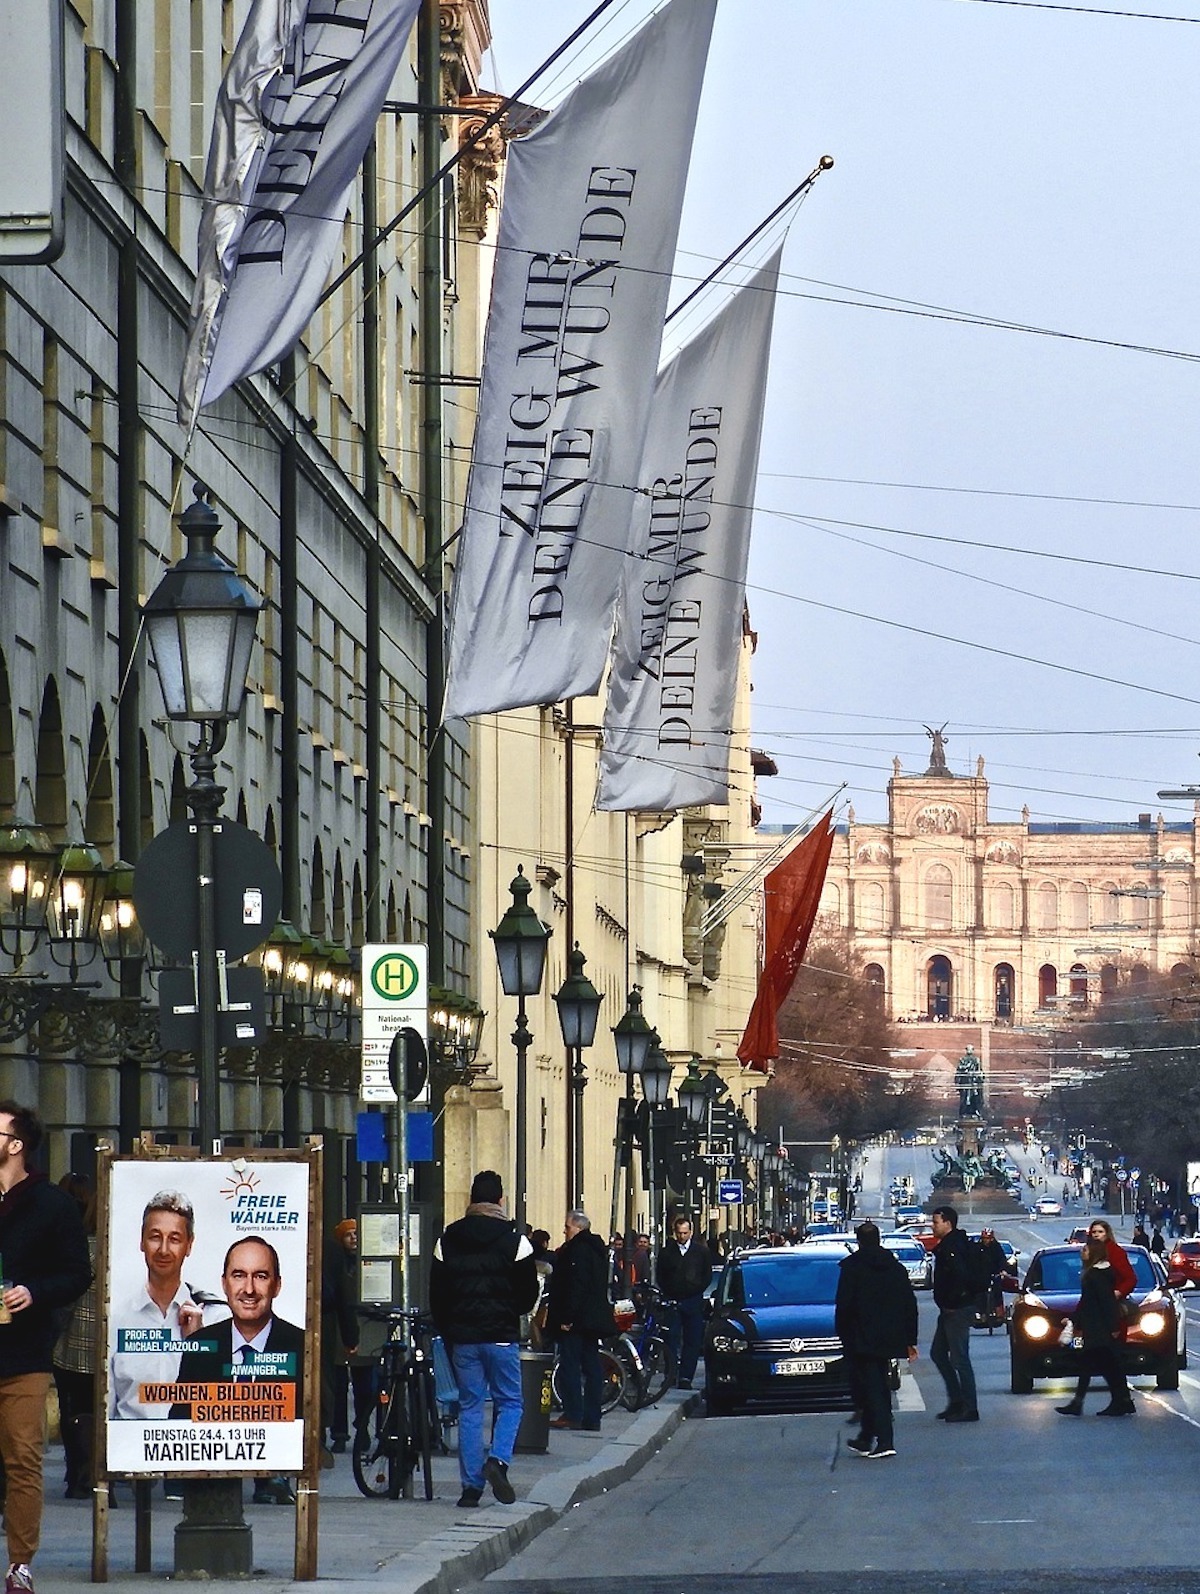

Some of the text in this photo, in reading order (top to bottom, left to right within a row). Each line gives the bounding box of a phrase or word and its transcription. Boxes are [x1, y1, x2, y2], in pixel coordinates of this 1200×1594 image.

[499, 250, 573, 538] ZEIG MIR
[527, 166, 637, 630] DEINE WUNDE
[630, 473, 683, 682] ZEIG MIR
[657, 406, 723, 751] DEINE WUNDE
[385, 963, 404, 990] H
[238, 1195, 287, 1208] FREIE
[230, 1208, 299, 1223] WÄHLER
[125, 1330, 164, 1340] PROF. DR.
[124, 1341, 162, 1351] MICHAEL
[163, 1341, 199, 1351] PIAZOLO
[254, 1353, 288, 1363] HUBERT
[231, 1365, 277, 1375] AIWANGER
[144, 1384, 287, 1401] WOHNEN. BILDUNG.
[197, 1405, 287, 1421] SICHERHEIT.
[143, 1428, 266, 1441] DIENSTAG 24.4. 13 UHR
[144, 1442, 266, 1461] MARIENPLATZ
